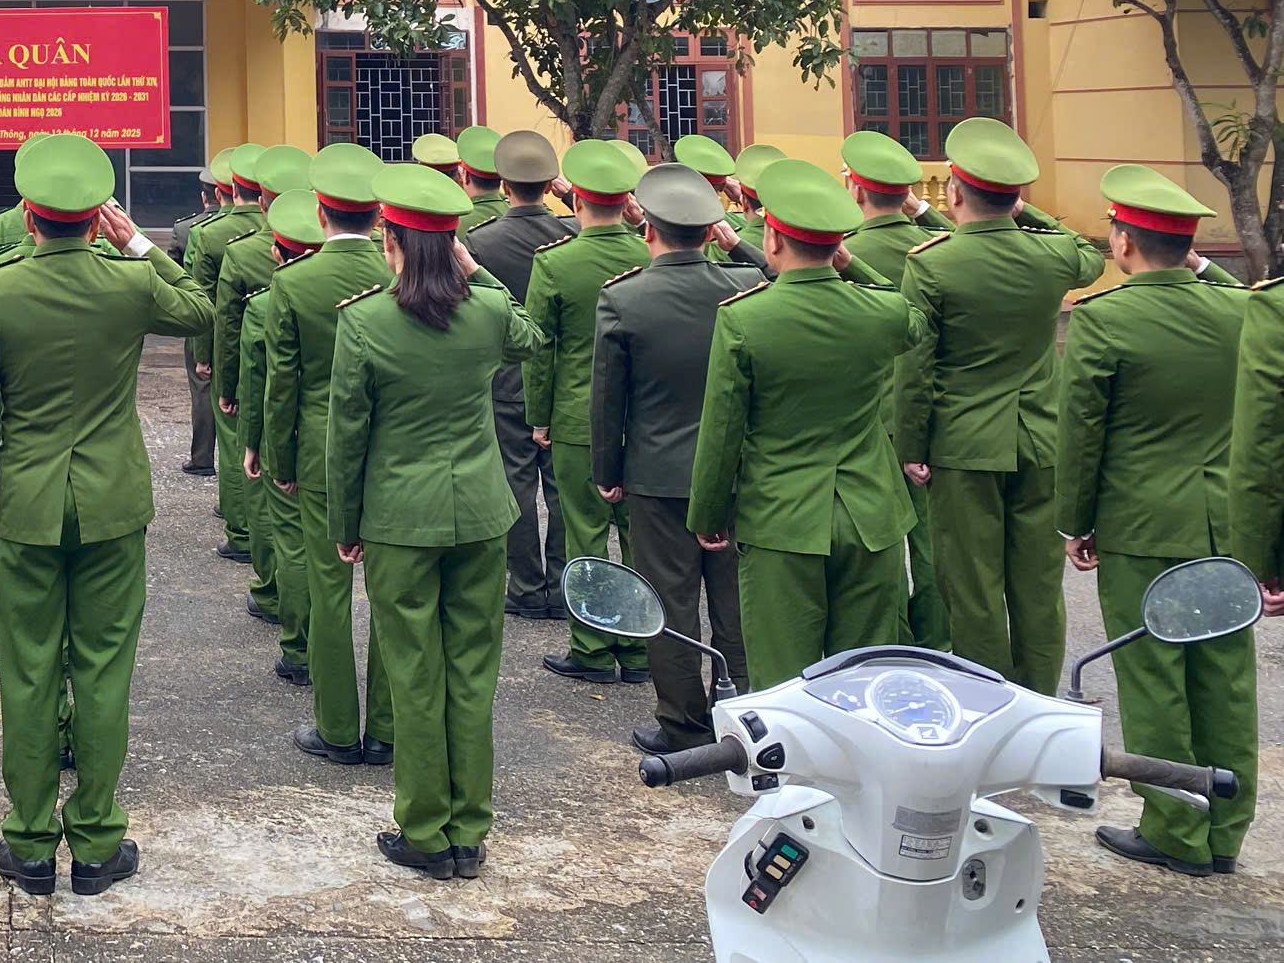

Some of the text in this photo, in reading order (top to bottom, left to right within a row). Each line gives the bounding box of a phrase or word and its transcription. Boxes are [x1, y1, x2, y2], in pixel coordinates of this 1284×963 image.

[8, 37, 92, 70] QUÂN
[111, 92, 128, 102] 2026
[133, 92, 150, 102] 2031
[45, 107, 63, 117] 2026
[89, 128, 100, 138] 12
[121, 128, 142, 138] 2025
